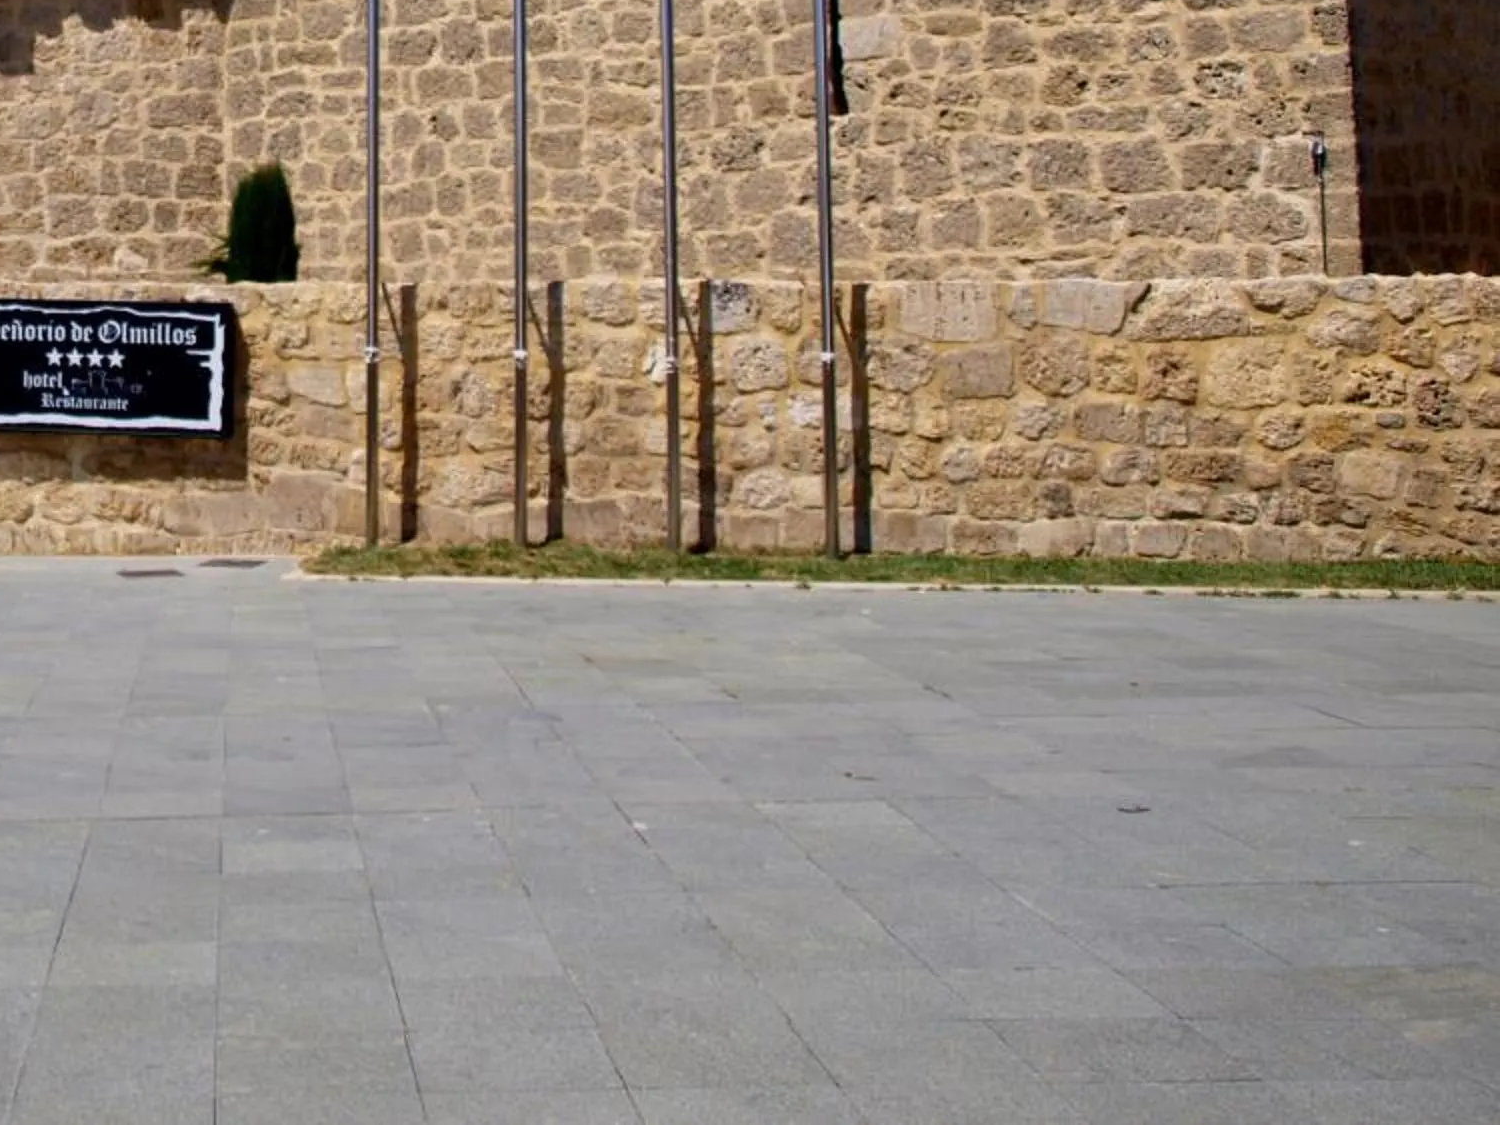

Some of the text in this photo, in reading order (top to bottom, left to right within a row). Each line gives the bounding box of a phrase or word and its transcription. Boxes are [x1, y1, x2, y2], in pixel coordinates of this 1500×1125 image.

[70, 320, 94, 343] de
[98, 319, 198, 346] Olmillos
[23, 370, 63, 390] hotel
[41, 392, 129, 411] Restaurante
